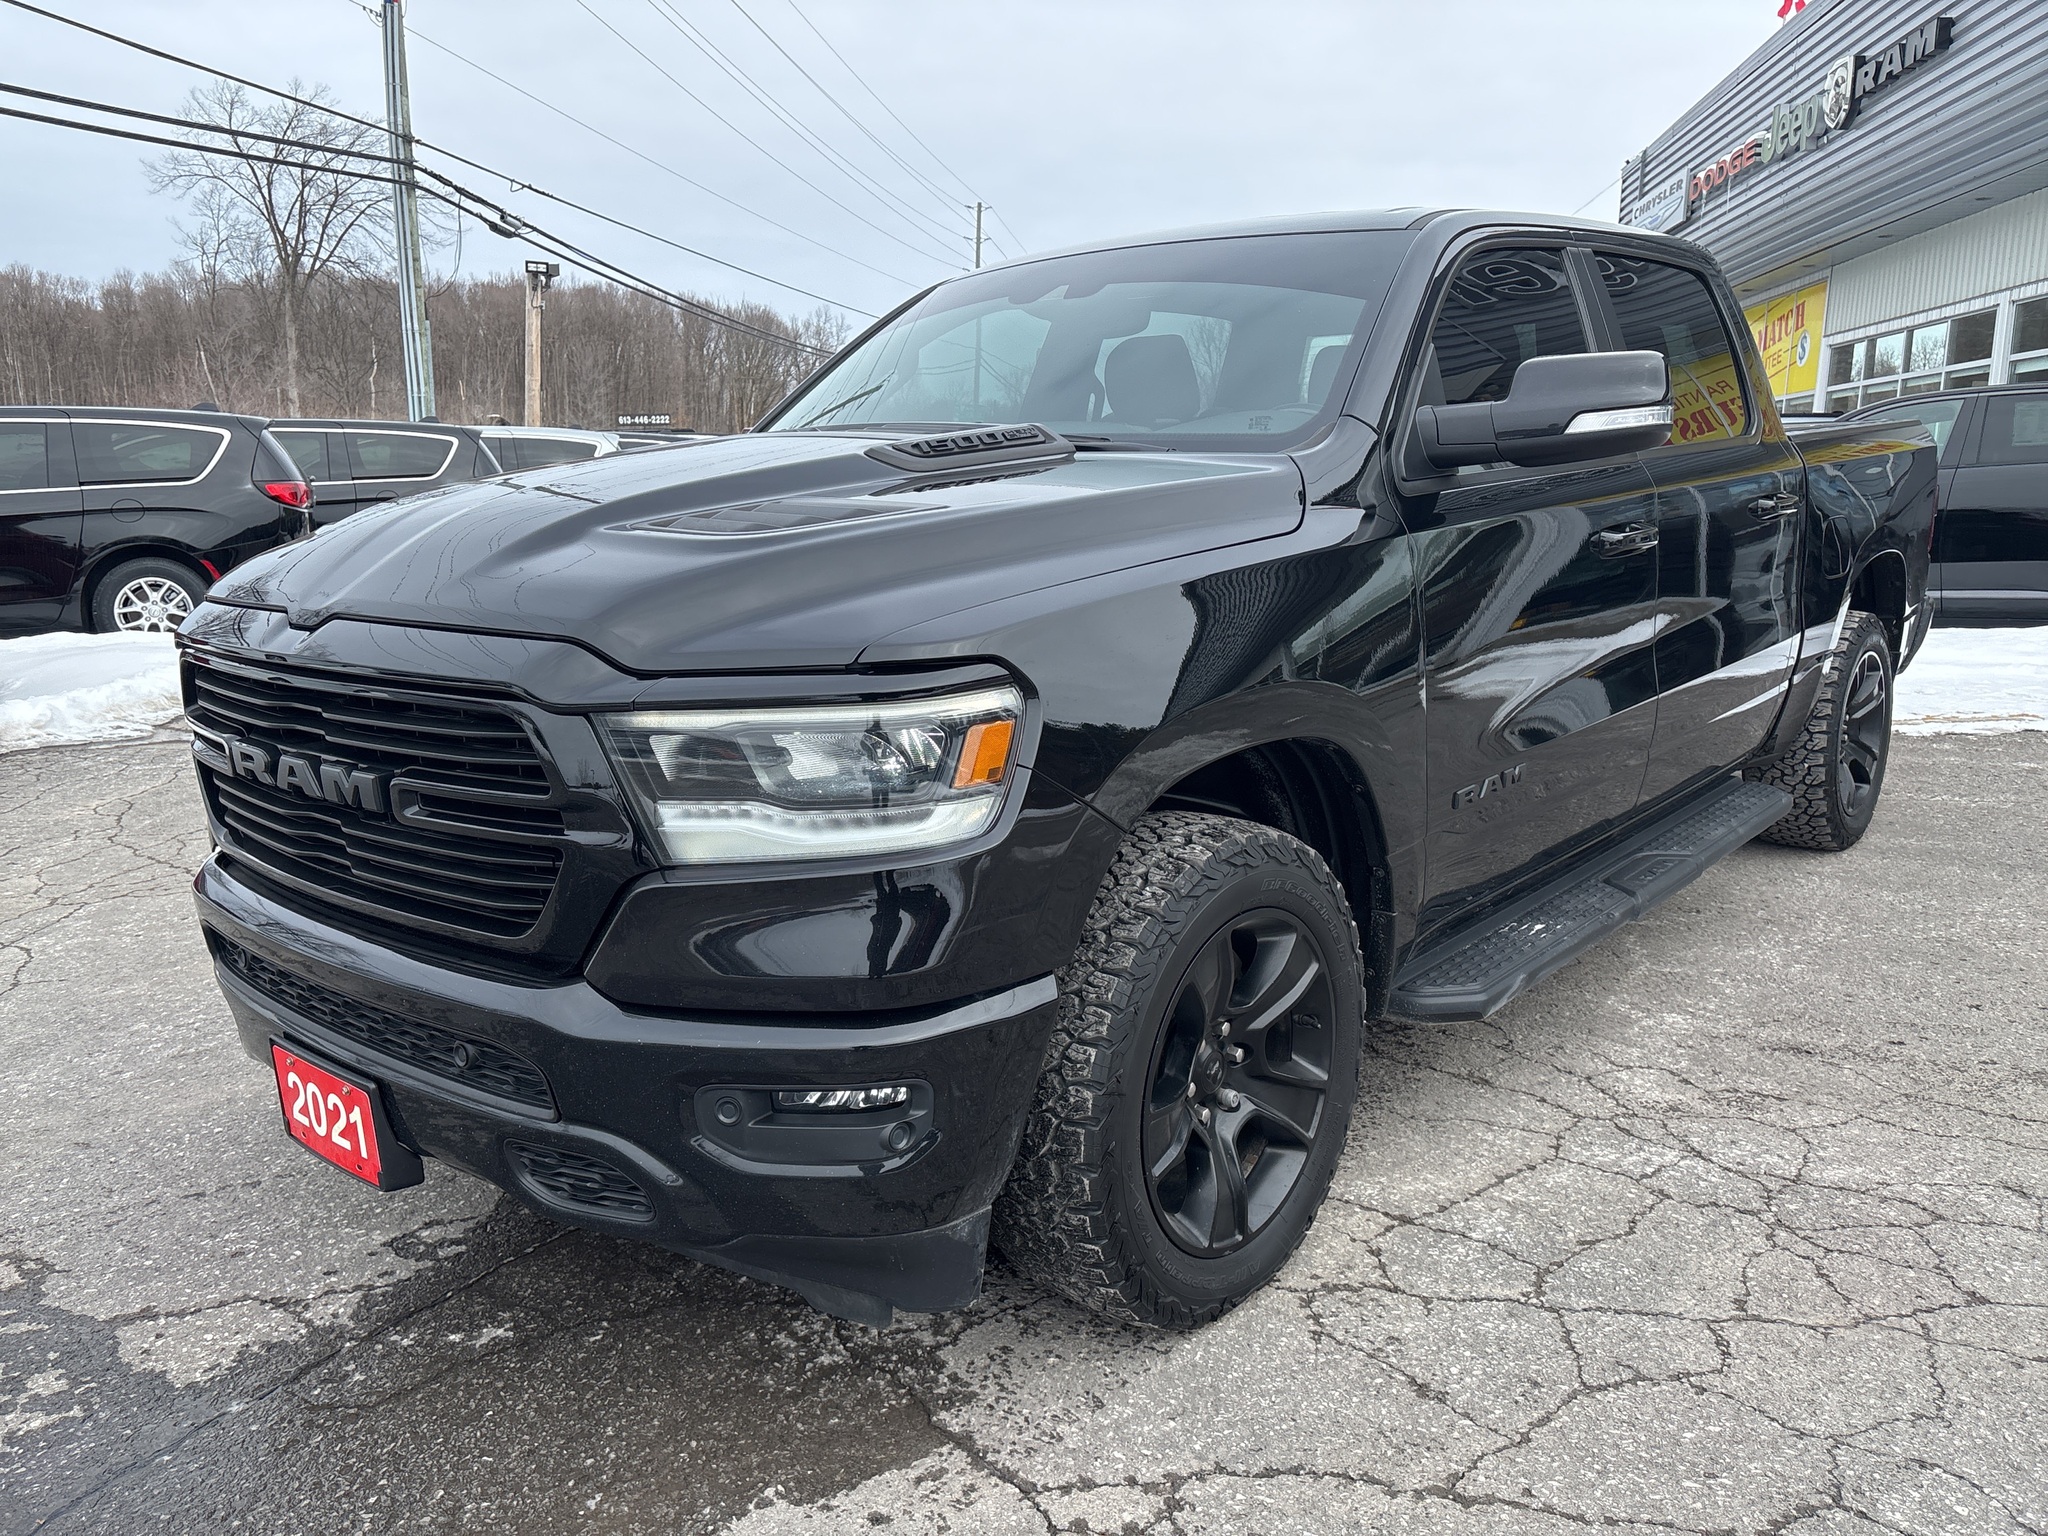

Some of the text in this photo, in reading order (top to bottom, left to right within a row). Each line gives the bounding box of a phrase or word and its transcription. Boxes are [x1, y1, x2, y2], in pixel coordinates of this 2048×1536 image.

[1855, 19, 1938, 99] RAM
[1761, 94, 1818, 164] Jeep
[1689, 138, 1756, 201] DODGE
[1634, 178, 1684, 220] CHRYSLER
[1757, 300, 1806, 353] MATCH
[618, 415, 670, 424] 613-446-2222
[910, 431, 1005, 454] 1500
[231, 739, 384, 814] RAM
[1451, 762, 1526, 810] RAM
[287, 1071, 368, 1160] 2021
